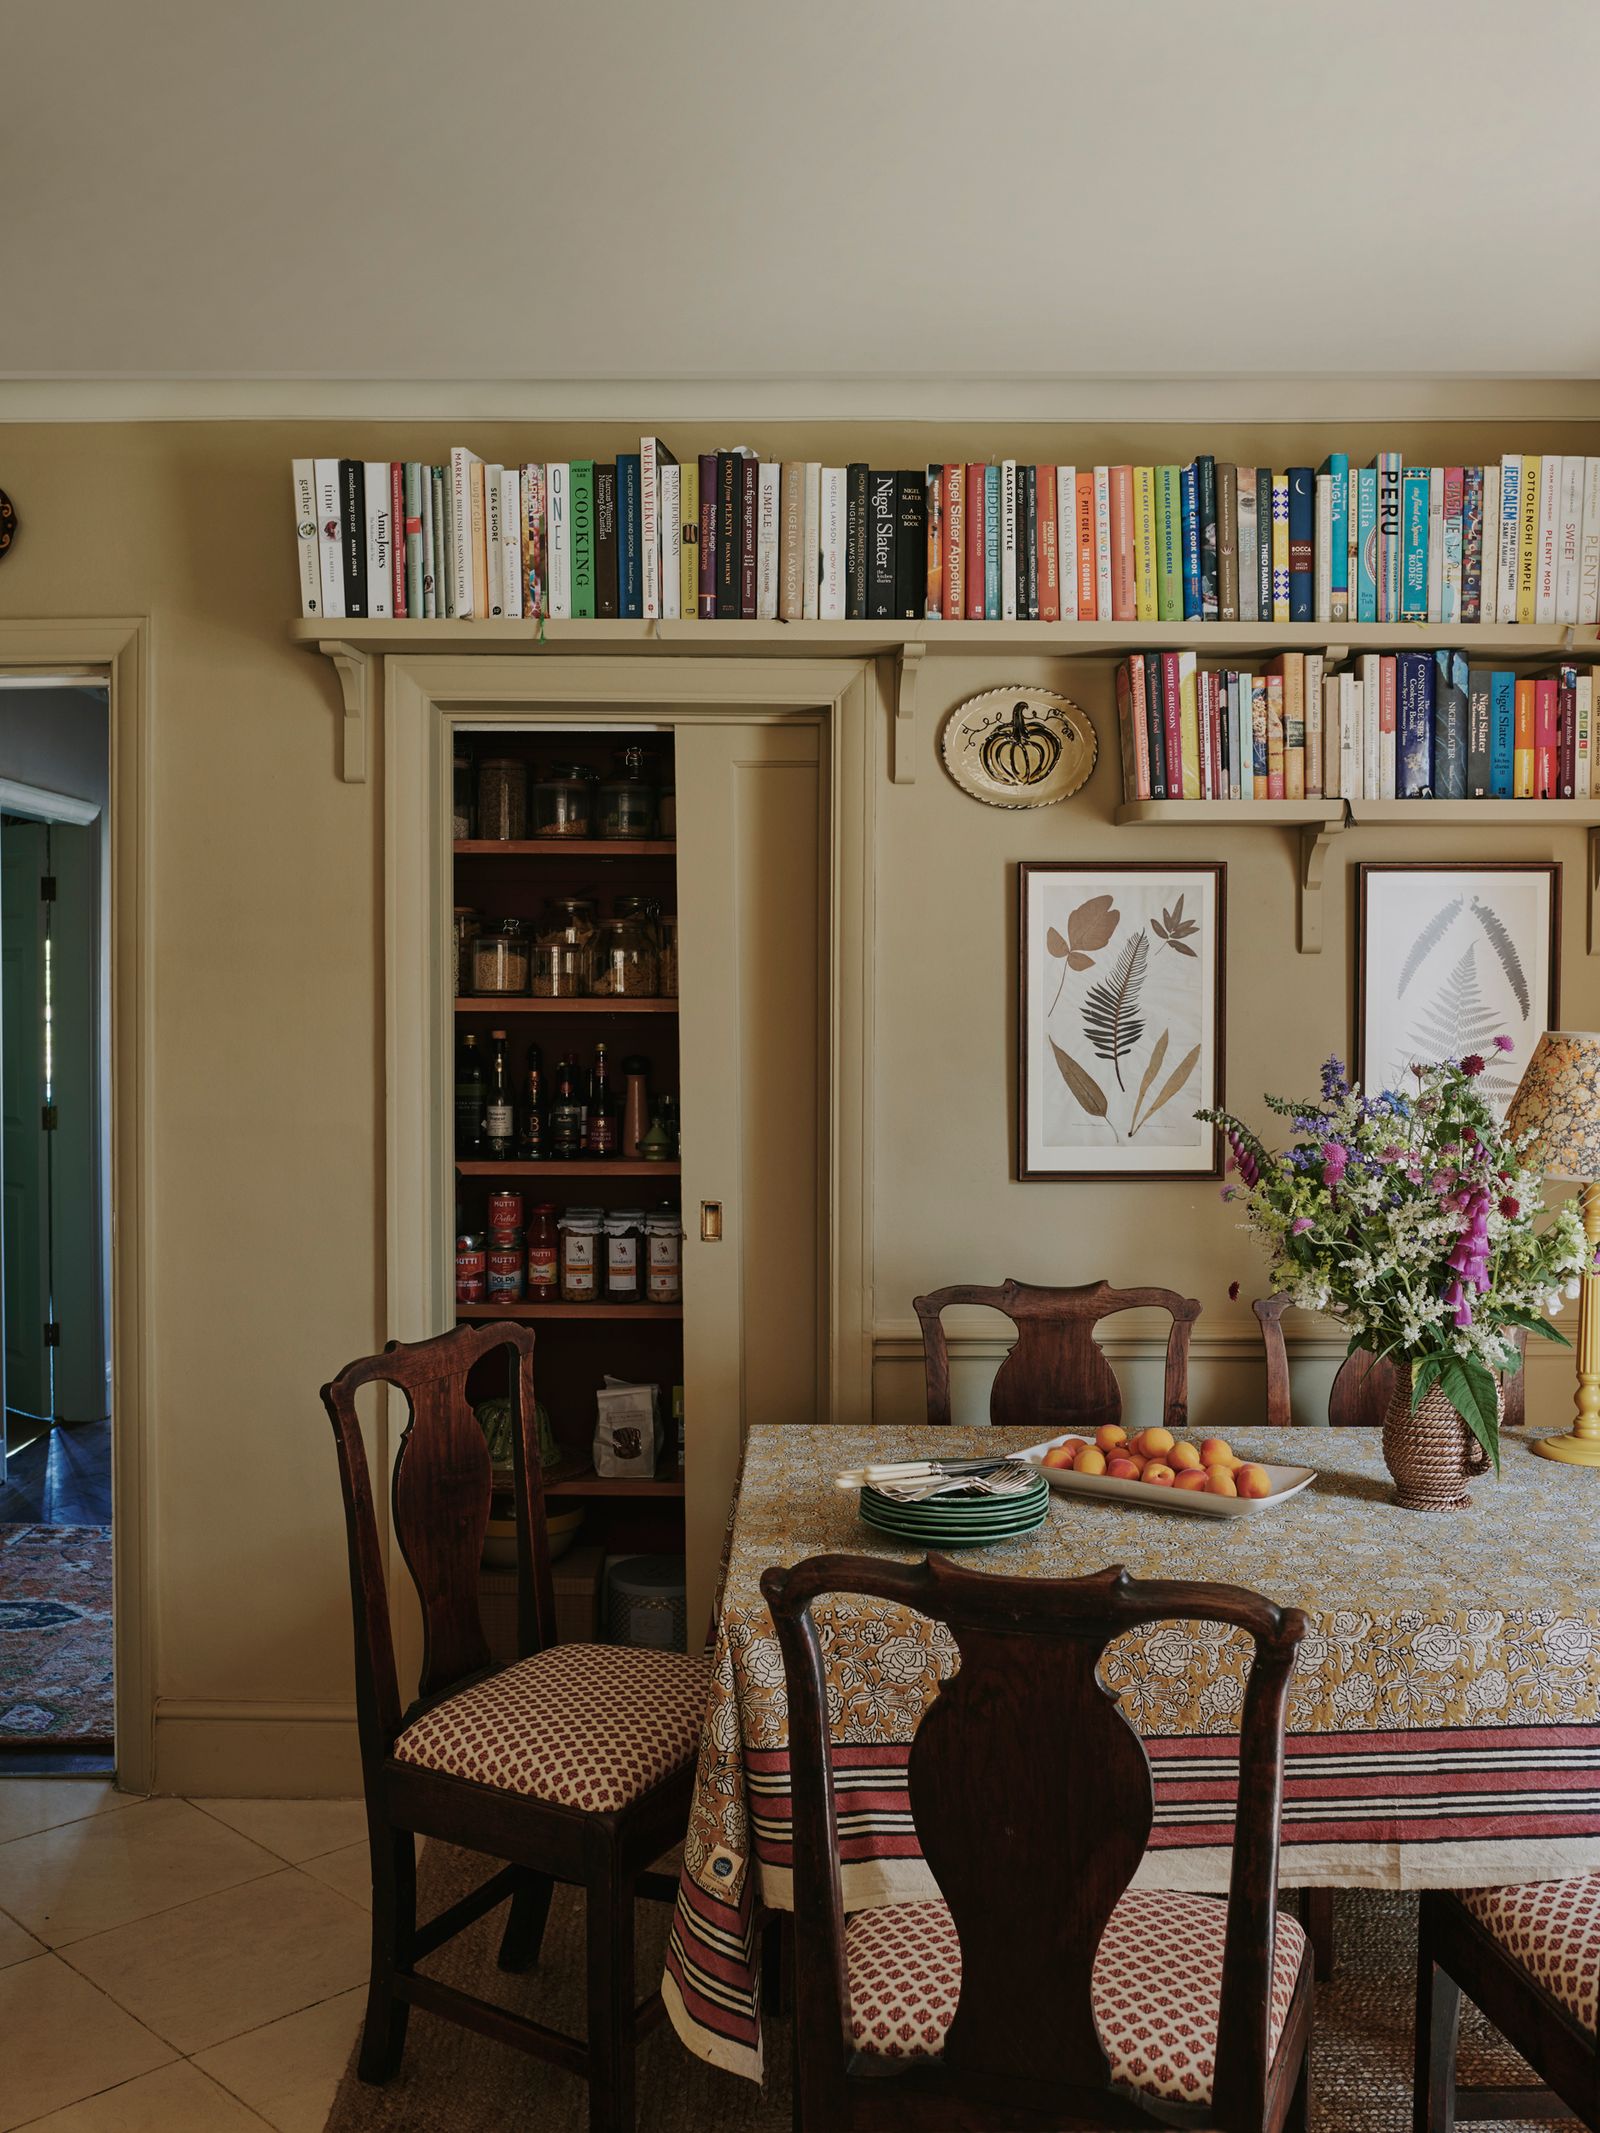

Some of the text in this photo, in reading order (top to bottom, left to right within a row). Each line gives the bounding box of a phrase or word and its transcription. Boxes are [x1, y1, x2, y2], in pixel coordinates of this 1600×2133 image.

[299, 480, 311, 515] gather
[325, 485, 335, 512] time
[490, 488, 498, 503] SEA
[643, 445, 654, 544] WEEK IN WEEK OUT
[671, 471, 679, 501] SIMON
[744, 490, 755, 504] figs
[858, 495, 864, 504] TO
[1261, 478, 1268, 489] MY
[1332, 473, 1341, 521] PUGLIA
[1362, 478, 1374, 528] Sicilia
[1381, 471, 1398, 536] PERU
[1503, 466, 1518, 520] JERUSALEM
[456, 499, 464, 531] BRITISH
[472, 482, 481, 533] sugar club
[553, 469, 561, 550] ONE
[605, 502, 613, 532] Wareing
[702, 504, 709, 514] No
[744, 506, 753, 528] sugar
[764, 485, 772, 528] SIMPLE
[858, 507, 864, 516] BE
[872, 478, 893, 567] Nigel Slater
[987, 482, 998, 566] HIDDEN HUT
[1446, 482, 1460, 534] BASQUE
[375, 510, 389, 568] Anna Jones
[575, 488, 589, 587] COOKING
[788, 470, 798, 600] FEAST NIGELLA LAWSON
[949, 469, 961, 601] Nigel Slater Appetite
[1523, 471, 1535, 592] OTTOLENGHI SIMPLE
[1565, 523, 1575, 561] SWEET
[830, 571, 836, 581] TO
[1047, 547, 1055, 588] SEASONS
[1082, 548, 1090, 561] THE
[1408, 554, 1416, 586] RODEN
[1415, 549, 1423, 591] CLAUDIA
[1583, 535, 1598, 600] PLENTY
[1167, 658, 1176, 728] SOPHIE GRIGSON
[1408, 679, 1417, 708] Cookery
[1477, 693, 1488, 753] Nigel Slater
[1496, 685, 1509, 748] Nigel Slater
[1579, 711, 1588, 759] APPLE
[530, 1116, 540, 1132] B
